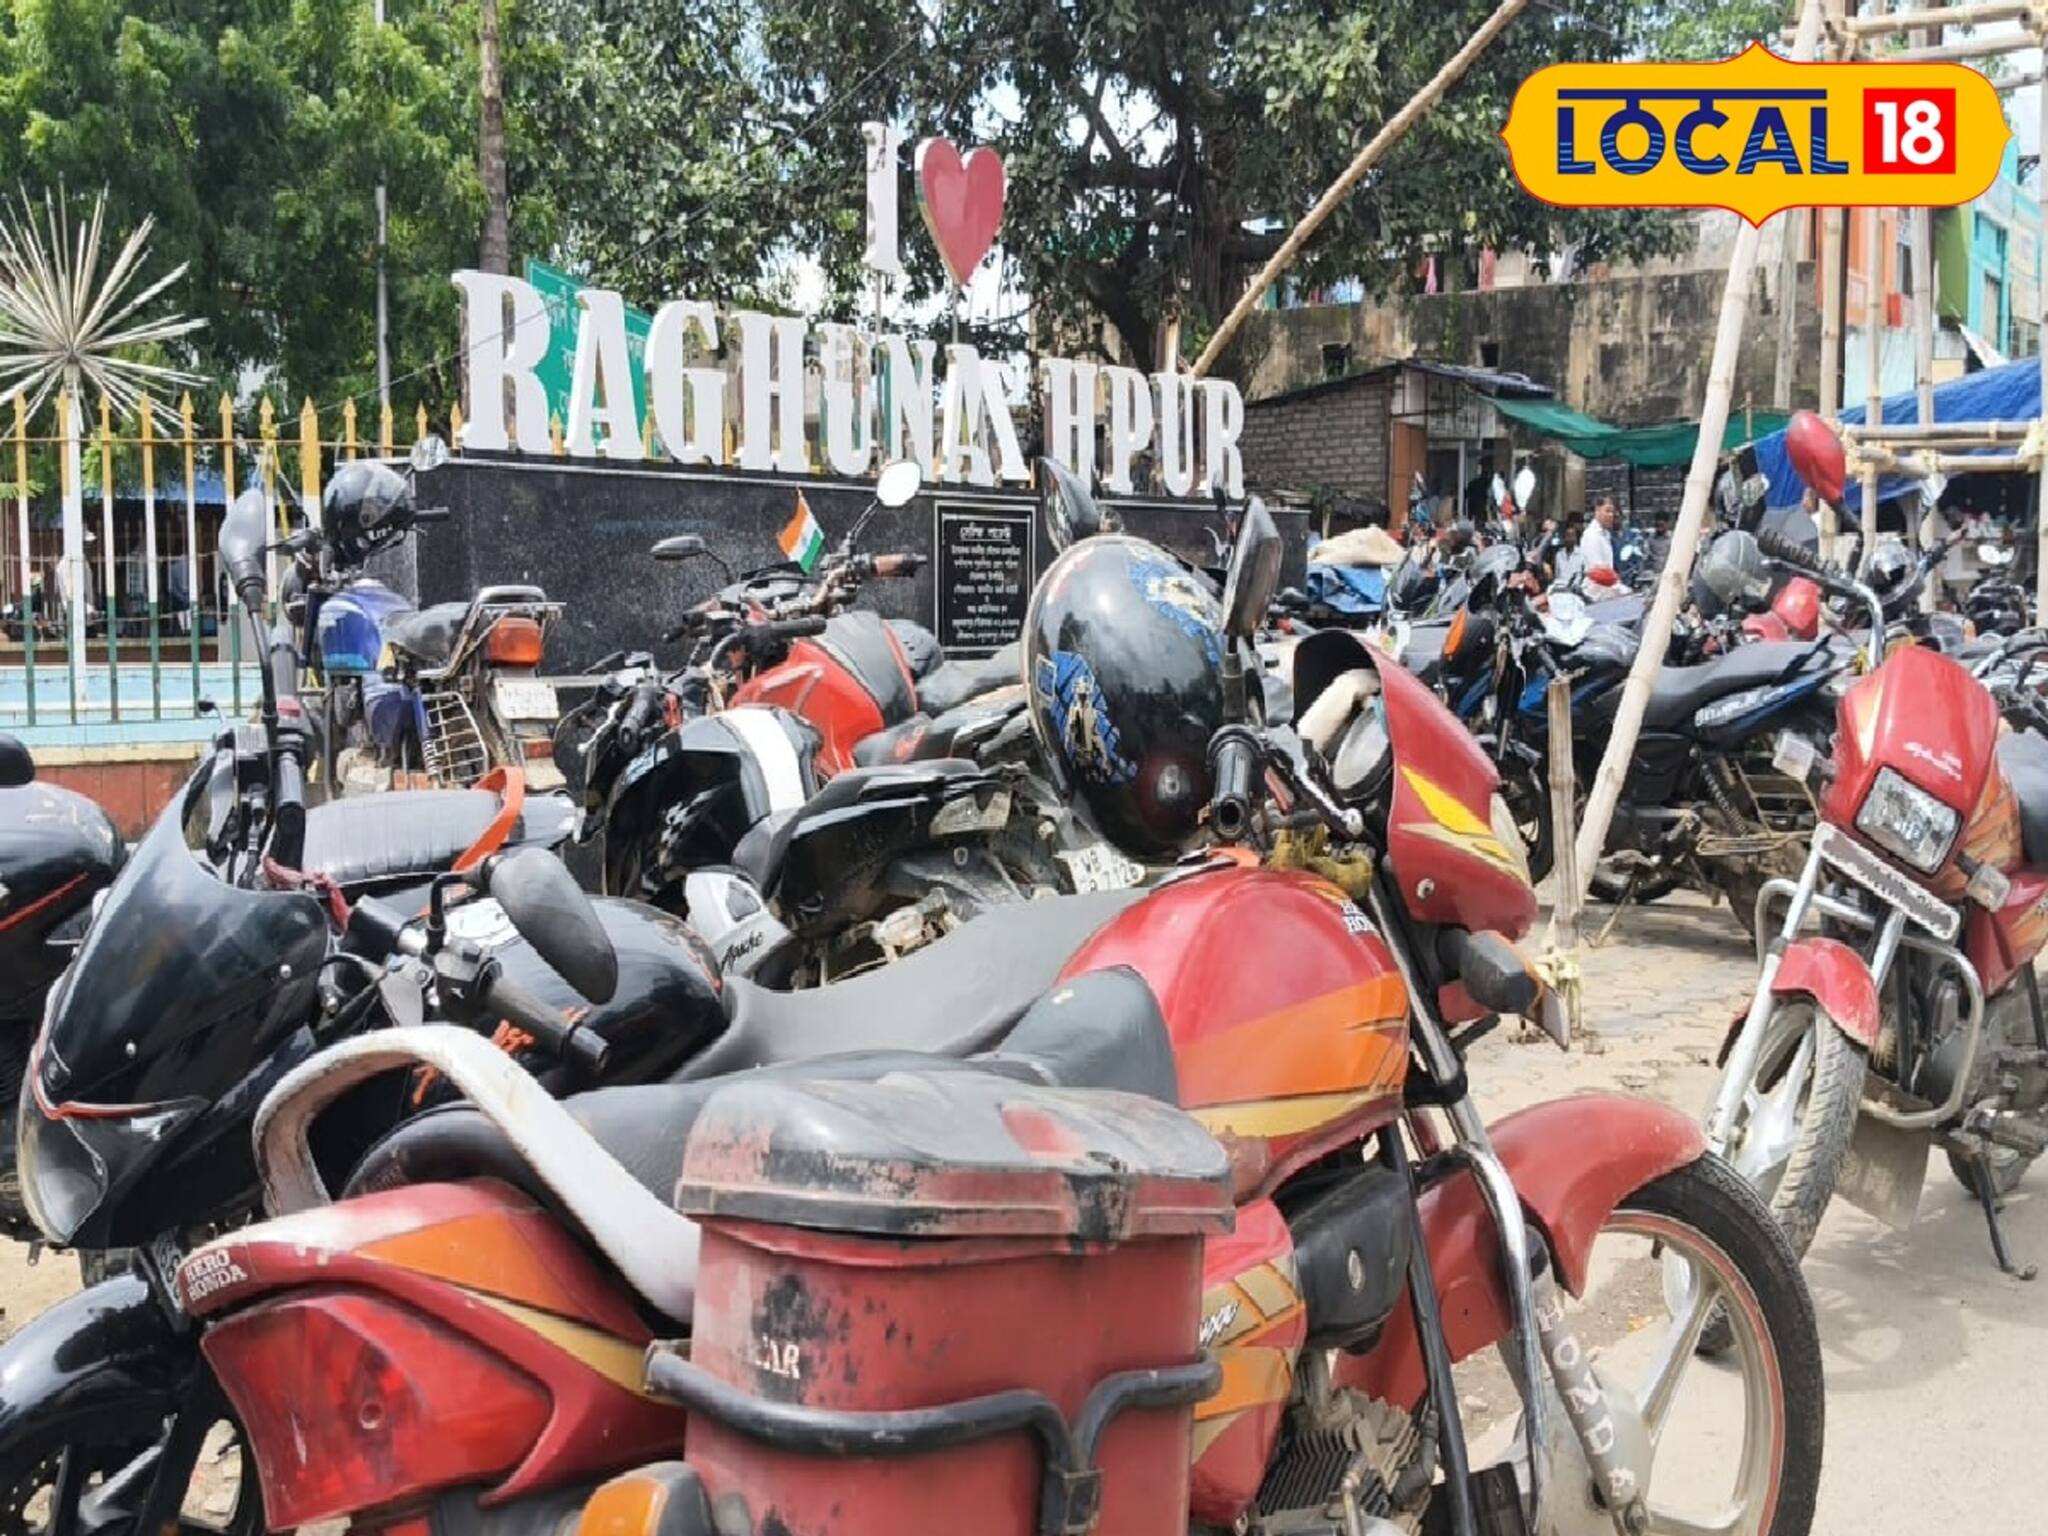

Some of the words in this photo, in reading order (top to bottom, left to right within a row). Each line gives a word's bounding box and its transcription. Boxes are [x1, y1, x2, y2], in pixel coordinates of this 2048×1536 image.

[861, 120, 908, 275] I
[185, 1249, 230, 1283] HERO
[187, 1265, 248, 1302] HONDA
